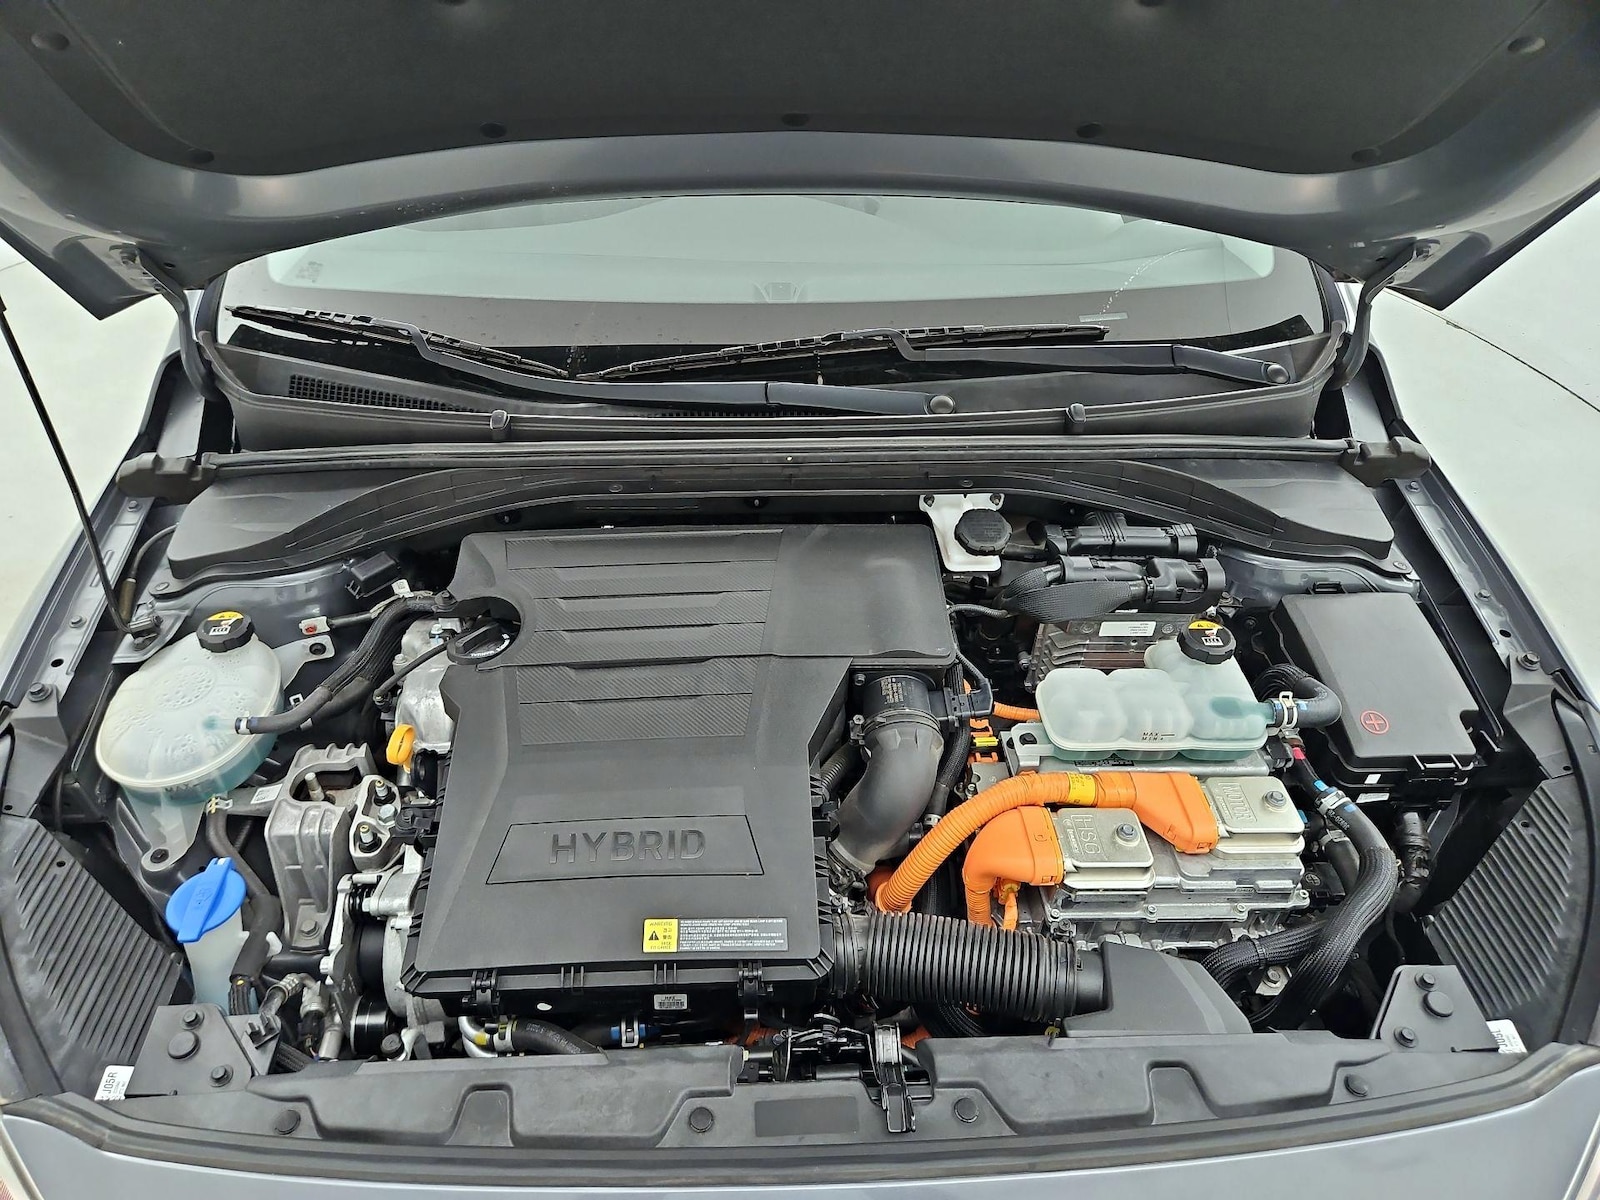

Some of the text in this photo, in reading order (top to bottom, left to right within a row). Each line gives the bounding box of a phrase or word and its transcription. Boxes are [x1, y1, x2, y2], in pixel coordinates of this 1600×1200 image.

[549, 829, 706, 864] HYBRID
[1075, 818, 1101, 854] HSG
[102, 1071, 118, 1094] J05R
